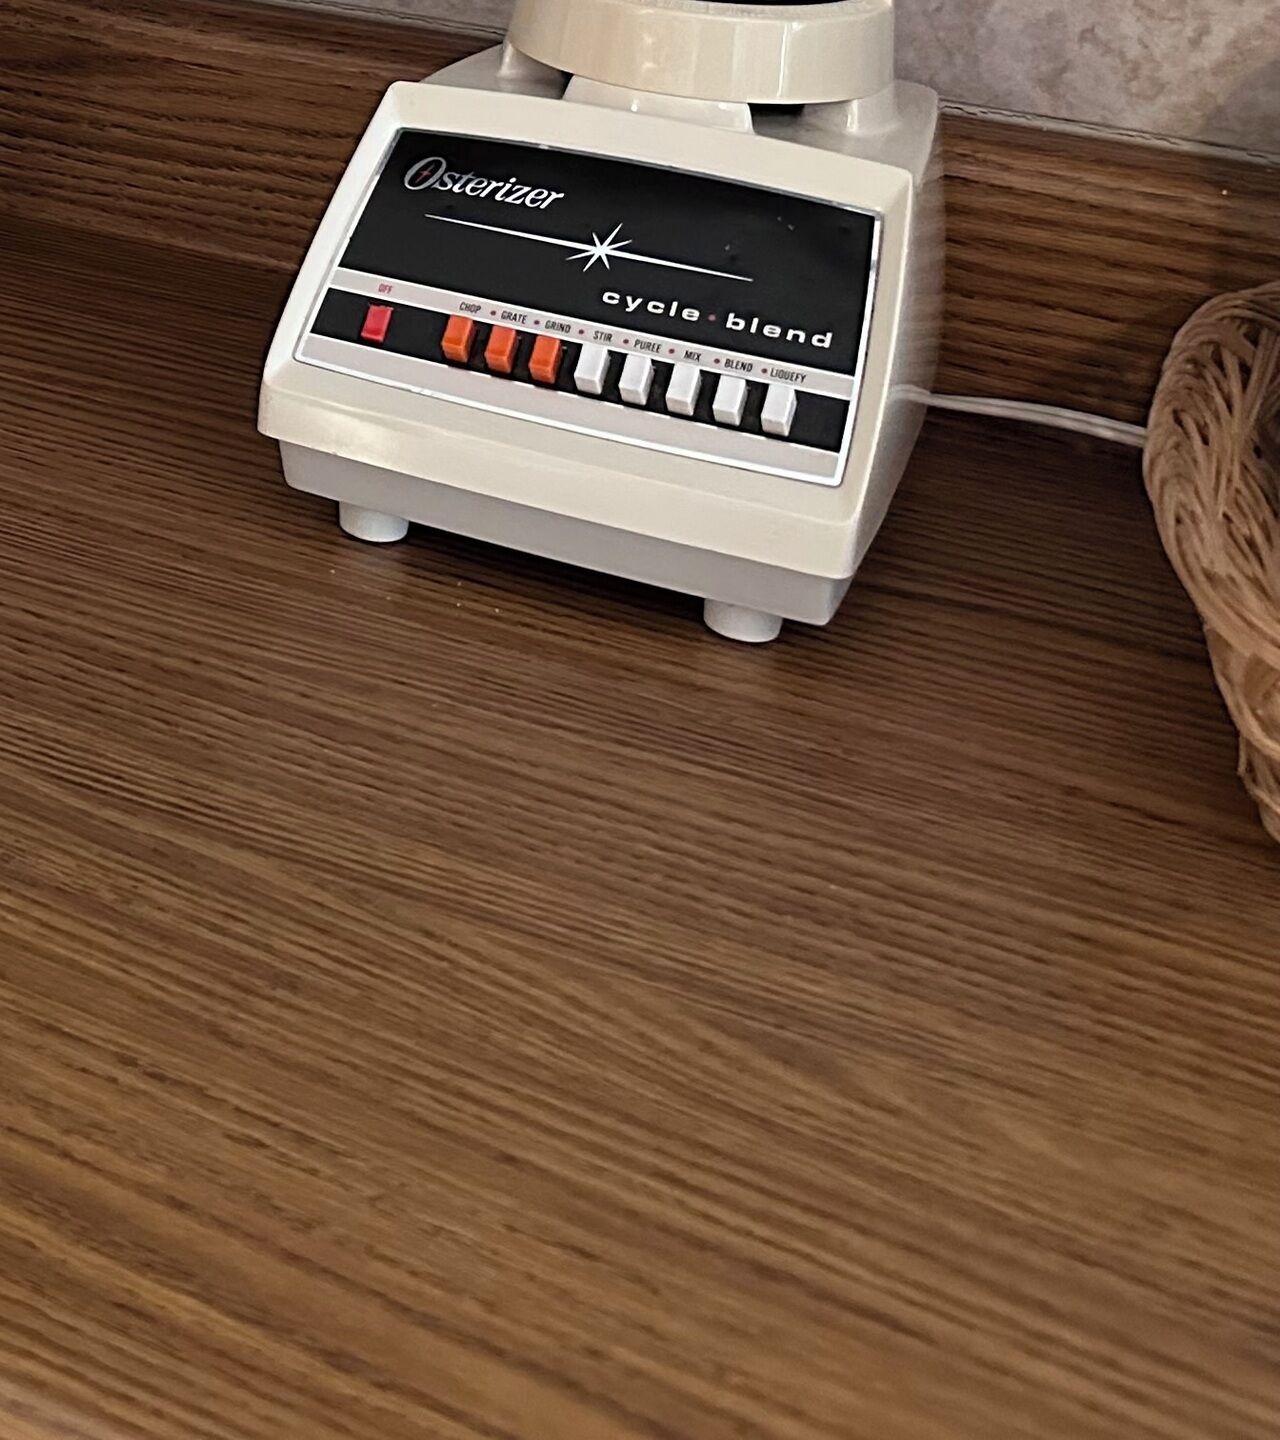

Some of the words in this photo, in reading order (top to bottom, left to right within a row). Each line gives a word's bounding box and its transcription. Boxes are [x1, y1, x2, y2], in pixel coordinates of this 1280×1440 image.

[403, 156, 565, 209] Osterizer
[377, 283, 393, 295] OFF
[459, 301, 482, 314] CHOP
[500, 310, 528, 325] GRATE
[544, 320, 572, 334] GRIND
[592, 329, 613, 343] STIR
[633, 339, 662, 354] PUREE
[683, 349, 702, 363] MIX
[724, 358, 754, 373] BLEND
[769, 367, 807, 384] LIQUEFY
[602, 291, 701, 322] cycle
[725, 312, 834, 349] blend
